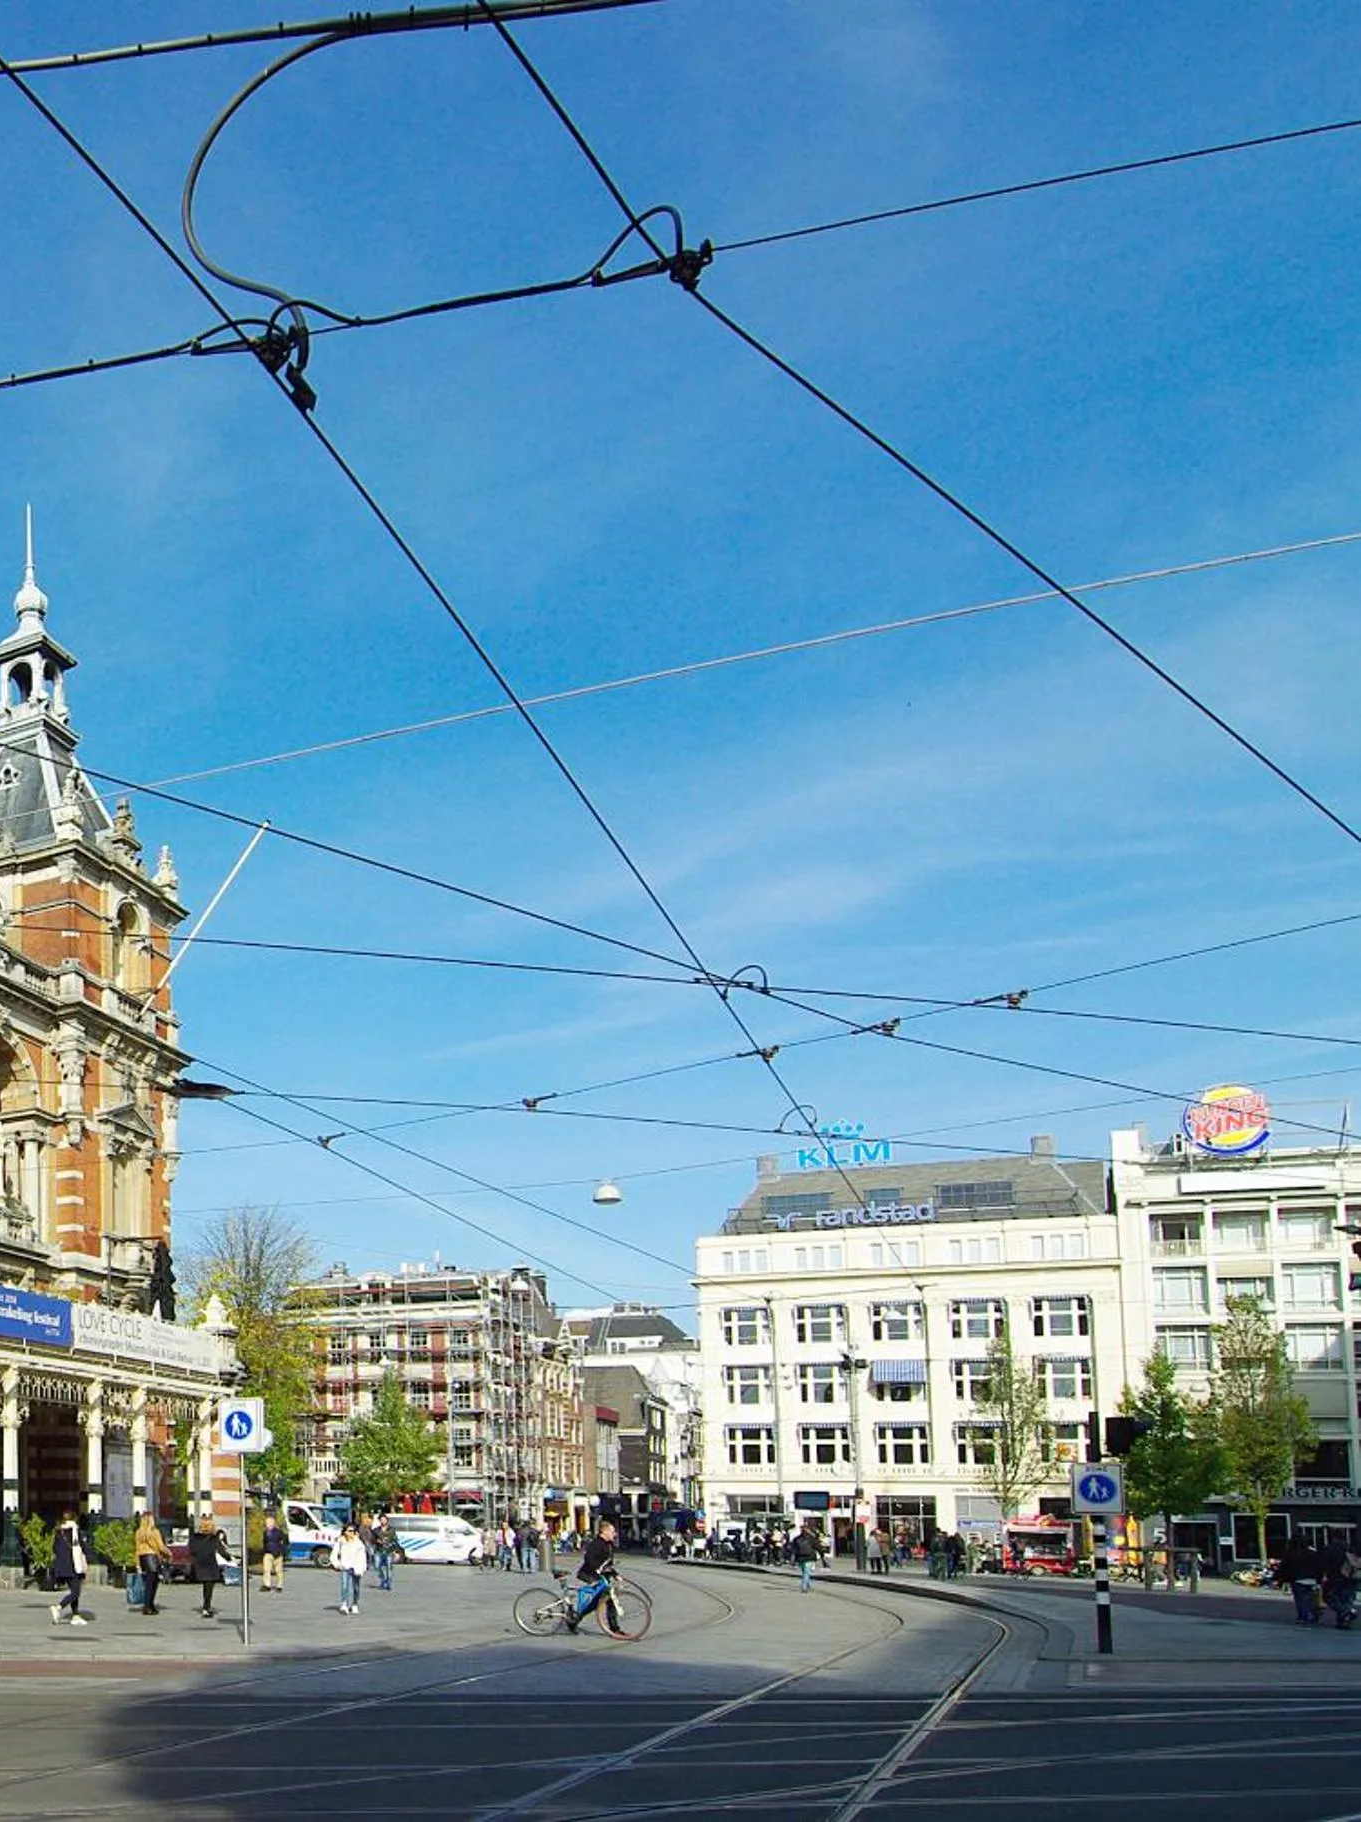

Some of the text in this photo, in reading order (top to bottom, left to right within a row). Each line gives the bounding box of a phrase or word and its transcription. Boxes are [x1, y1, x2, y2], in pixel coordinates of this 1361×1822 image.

[1195, 1111, 1266, 1140] KING
[799, 1140, 889, 1168] KLM
[815, 1197, 935, 1227] randstad
[78, 1308, 106, 1332] LOVE
[110, 1315, 143, 1339] CYCLE
